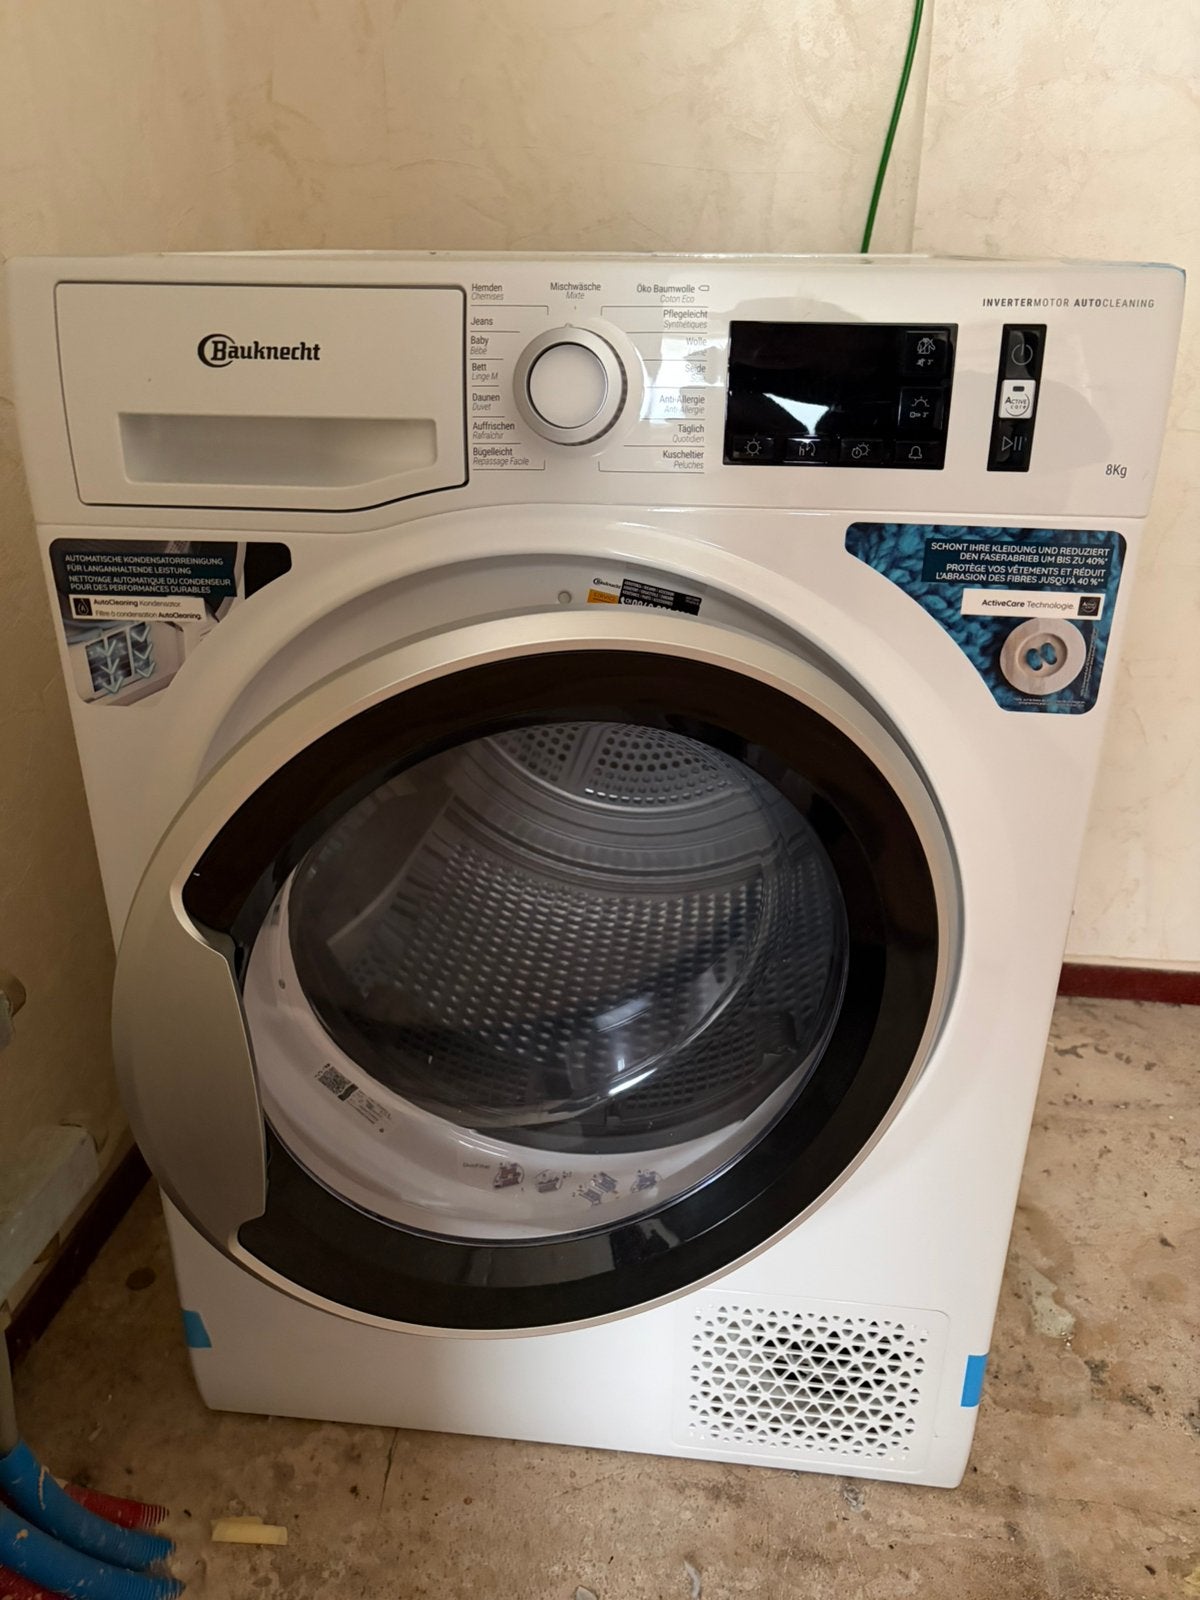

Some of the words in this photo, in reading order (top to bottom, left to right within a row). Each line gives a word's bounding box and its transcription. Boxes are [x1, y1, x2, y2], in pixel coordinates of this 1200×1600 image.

[471, 283, 503, 292] Hemden
[550, 282, 601, 291] Mischwäsche
[636, 283, 652, 293] Öko
[653, 284, 695, 293] Baumwolle
[471, 292, 504, 301] Chemises
[565, 291, 585, 300] Mixte
[660, 294, 681, 303] Coton
[681, 295, 695, 303] Eco
[982, 298, 1069, 307] INVERTERMOTOR
[1073, 298, 1155, 308] AUTOCLEANING
[663, 309, 708, 319] Pflegeleicht
[470, 317, 494, 326] Jeans
[663, 320, 708, 329] Synthétiques
[470, 335, 489, 346] Baby
[686, 337, 707, 346] Wolle
[198, 334, 320, 367] Bauknecht
[471, 363, 487, 371] Bett
[471, 372, 489, 382] Linge
[472, 393, 500, 402] Daunen
[472, 402, 491, 411] Duvet
[472, 421, 515, 430] Auffrischen
[678, 424, 705, 435] Täglich
[672, 434, 705, 443] Quotidien
[472, 447, 513, 458] Bügelleicht
[663, 450, 704, 459] Kuscheltier
[472, 457, 509, 467] Repassage
[509, 457, 530, 465] Facile
[673, 460, 704, 469] Peluches
[1105, 463, 1127, 478] 8Kg
[931, 542, 968, 551] SCHONT
[969, 543, 990, 552] IHRE
[991, 545, 1037, 553] KLEIDUNG
[1038, 546, 1059, 554] UND
[1059, 547, 1110, 556] REDUZIERT
[65, 554, 123, 563] AUTOMATISCHE
[123, 556, 223, 565] KONDENSATORREINIGUNG
[959, 552, 979, 560] DEN
[979, 553, 1039, 563] FASERABRIEB
[1040, 555, 1056, 563] UM
[1056, 556, 1071, 564] BIS
[1072, 556, 1085, 565] ZU
[66, 563, 82, 571] FÜR
[83, 565, 153, 574] LANGANHALTENDE
[154, 566, 192, 574] LEISTUNG
[946, 562, 986, 573] PROTÈGE
[987, 565, 1006, 573] VOS
[1007, 564, 1059, 575] VÊTEMENTS
[1060, 568, 1072, 576] ET
[1072, 567, 1106, 577] RÉDUIT
[69, 575, 112, 583] NETTOYAGE
[113, 576, 166, 585] AUTOMATIQUE
[166, 577, 178, 585] DU
[178, 578, 231, 586] CONDENSEUR
[936, 572, 986, 581] L'ABRASION
[988, 574, 1006, 582] DES
[1006, 575, 1037, 583] FIBRES
[1038, 575, 1076, 586] JUSQU'À
[1077, 577, 1089, 585] 40
[70, 583, 92, 591] POUR
[109, 584, 170, 593] PERFORMANCES
[170, 586, 211, 594] DURABLES
[93, 599, 138, 607] AutoCleaning
[982, 599, 1025, 608] ActiveCare
[158, 611, 202, 620] AutoCleaning.
